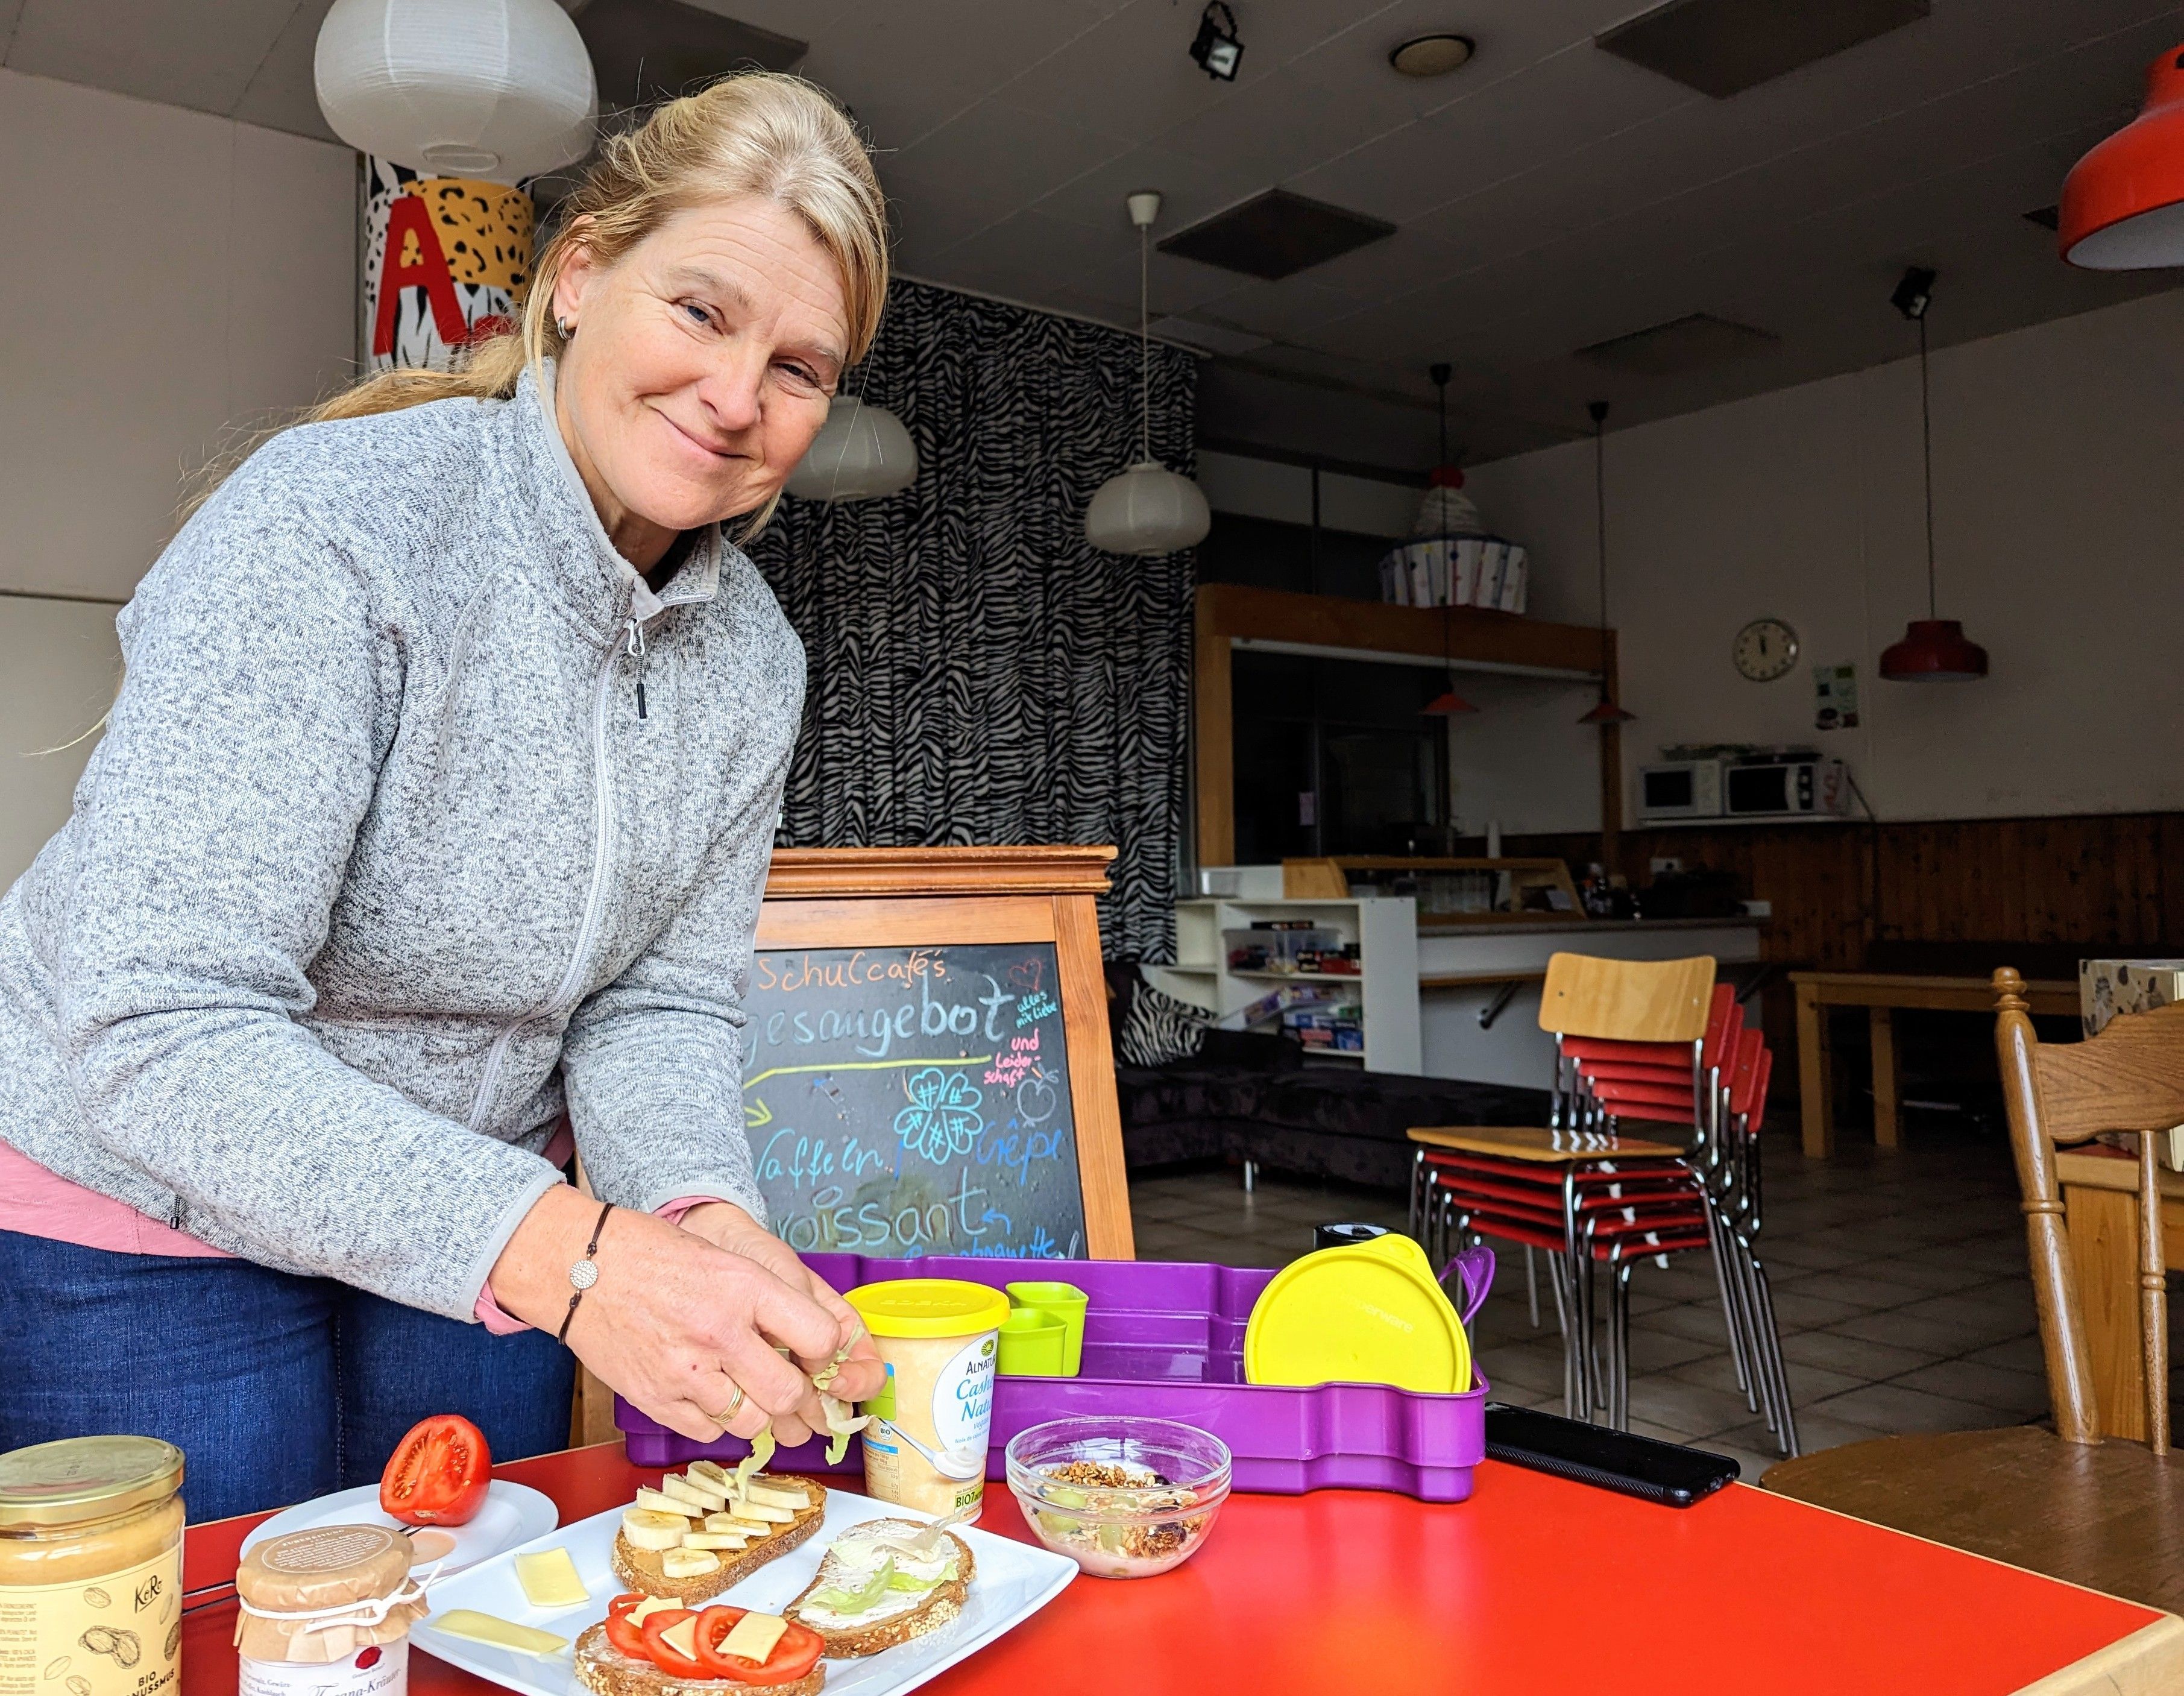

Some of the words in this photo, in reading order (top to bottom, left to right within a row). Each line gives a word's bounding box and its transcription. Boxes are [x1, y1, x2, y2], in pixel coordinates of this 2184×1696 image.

[1017, 991, 1048, 1013] alles
[742, 969, 1016, 1070] gesangebot
[1011, 1027, 1040, 1051] und
[776, 1166, 987, 1251] roissant
[1340, 1292, 1414, 1334] upperware
[966, 1354, 996, 1376] ALNATUR
[138, 1671, 156, 1688] BIO
